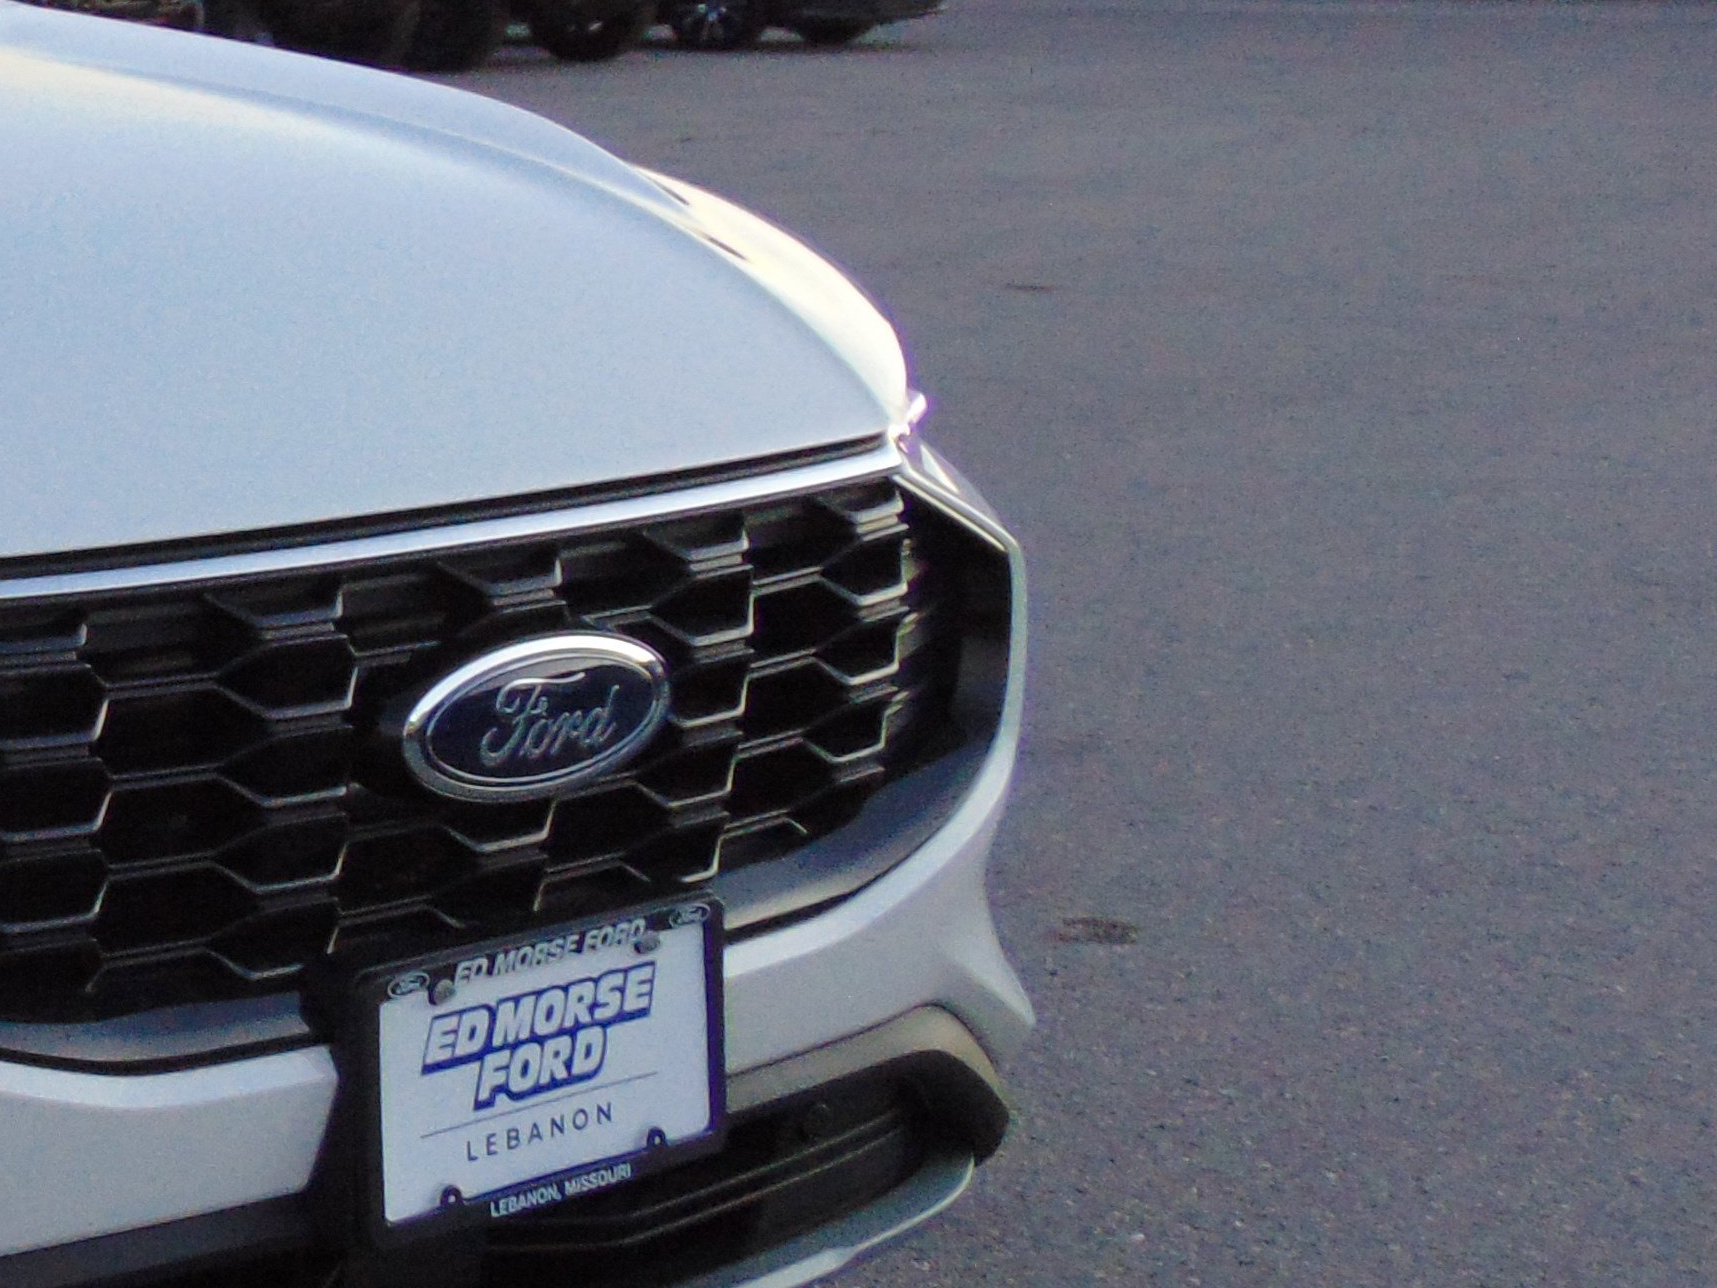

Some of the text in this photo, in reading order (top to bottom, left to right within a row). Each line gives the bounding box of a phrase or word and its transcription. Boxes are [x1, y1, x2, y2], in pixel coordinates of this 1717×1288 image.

[479, 671, 620, 766] Ford
[454, 956, 489, 987] ED
[493, 932, 581, 976] MORSE
[583, 918, 647, 954] FORD
[422, 961, 655, 1074] ED MORSE
[474, 1024, 608, 1110] FORD
[467, 1102, 613, 1161] LEBANON
[490, 1162, 632, 1218] LEBANON, MISSOURI
